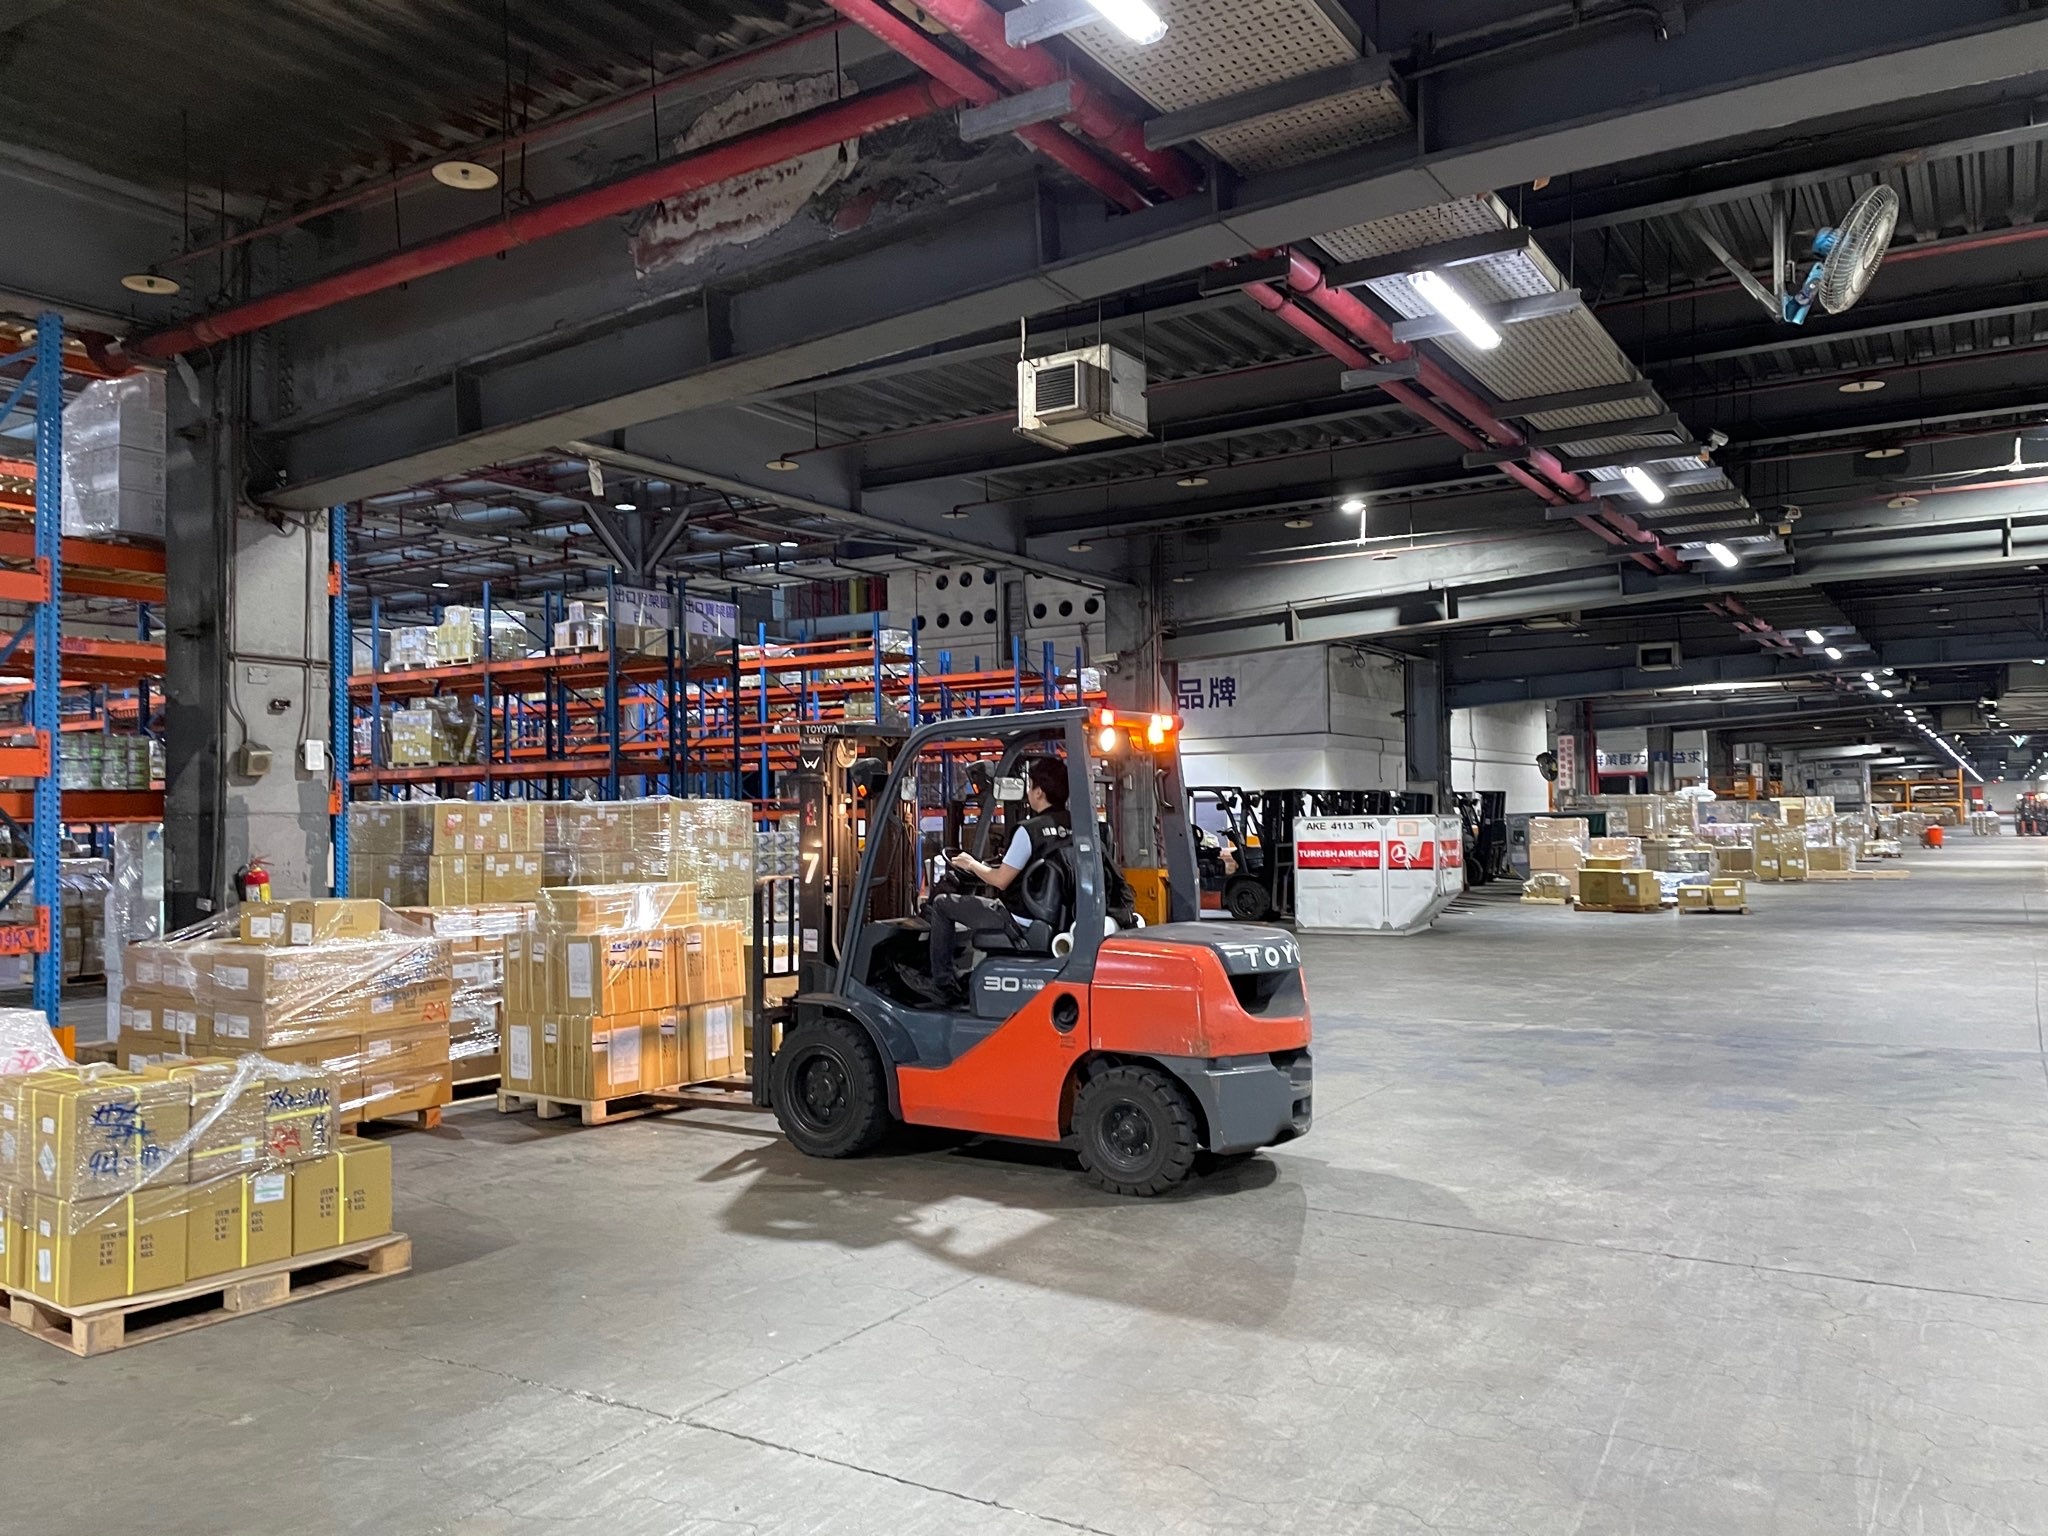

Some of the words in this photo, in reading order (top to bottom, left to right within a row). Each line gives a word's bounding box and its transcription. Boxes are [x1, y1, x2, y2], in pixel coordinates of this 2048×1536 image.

[1178, 676, 1237, 709] 品牌
[805, 724, 840, 734] TOYOTA
[1306, 822, 1326, 831] AKE
[1331, 822, 1354, 831] 4113
[1362, 821, 1375, 830] TK
[1299, 849, 1338, 858] TURKISH
[1338, 849, 1380, 858] AIRLINES
[802, 853, 820, 884] 7
[983, 976, 1020, 992] 30
